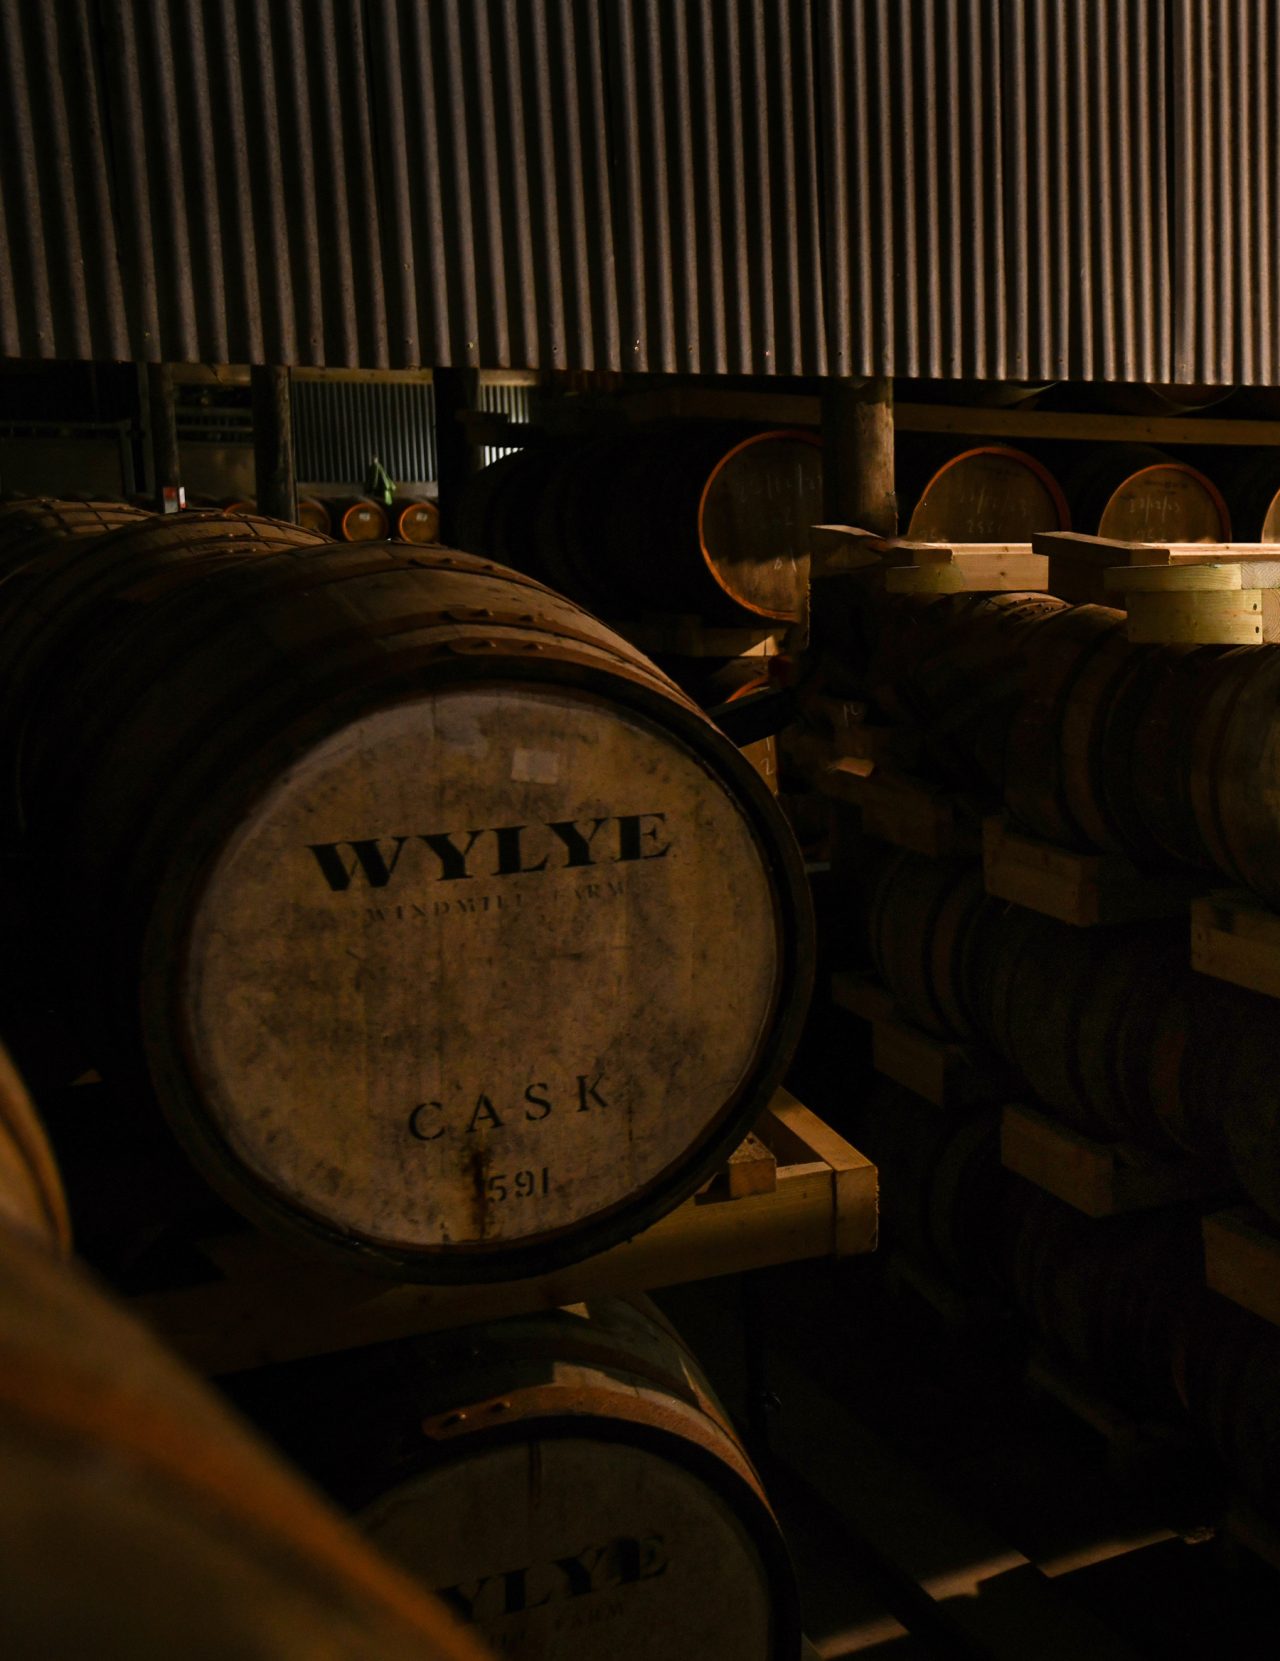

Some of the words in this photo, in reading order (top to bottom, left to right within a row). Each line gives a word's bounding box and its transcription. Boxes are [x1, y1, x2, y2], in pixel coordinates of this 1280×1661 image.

[305, 813, 672, 891] WYLYE
[408, 1072, 608, 1141] CASK
[488, 1167, 549, 1202] 591
[438, 1533, 671, 1621] YLYE
